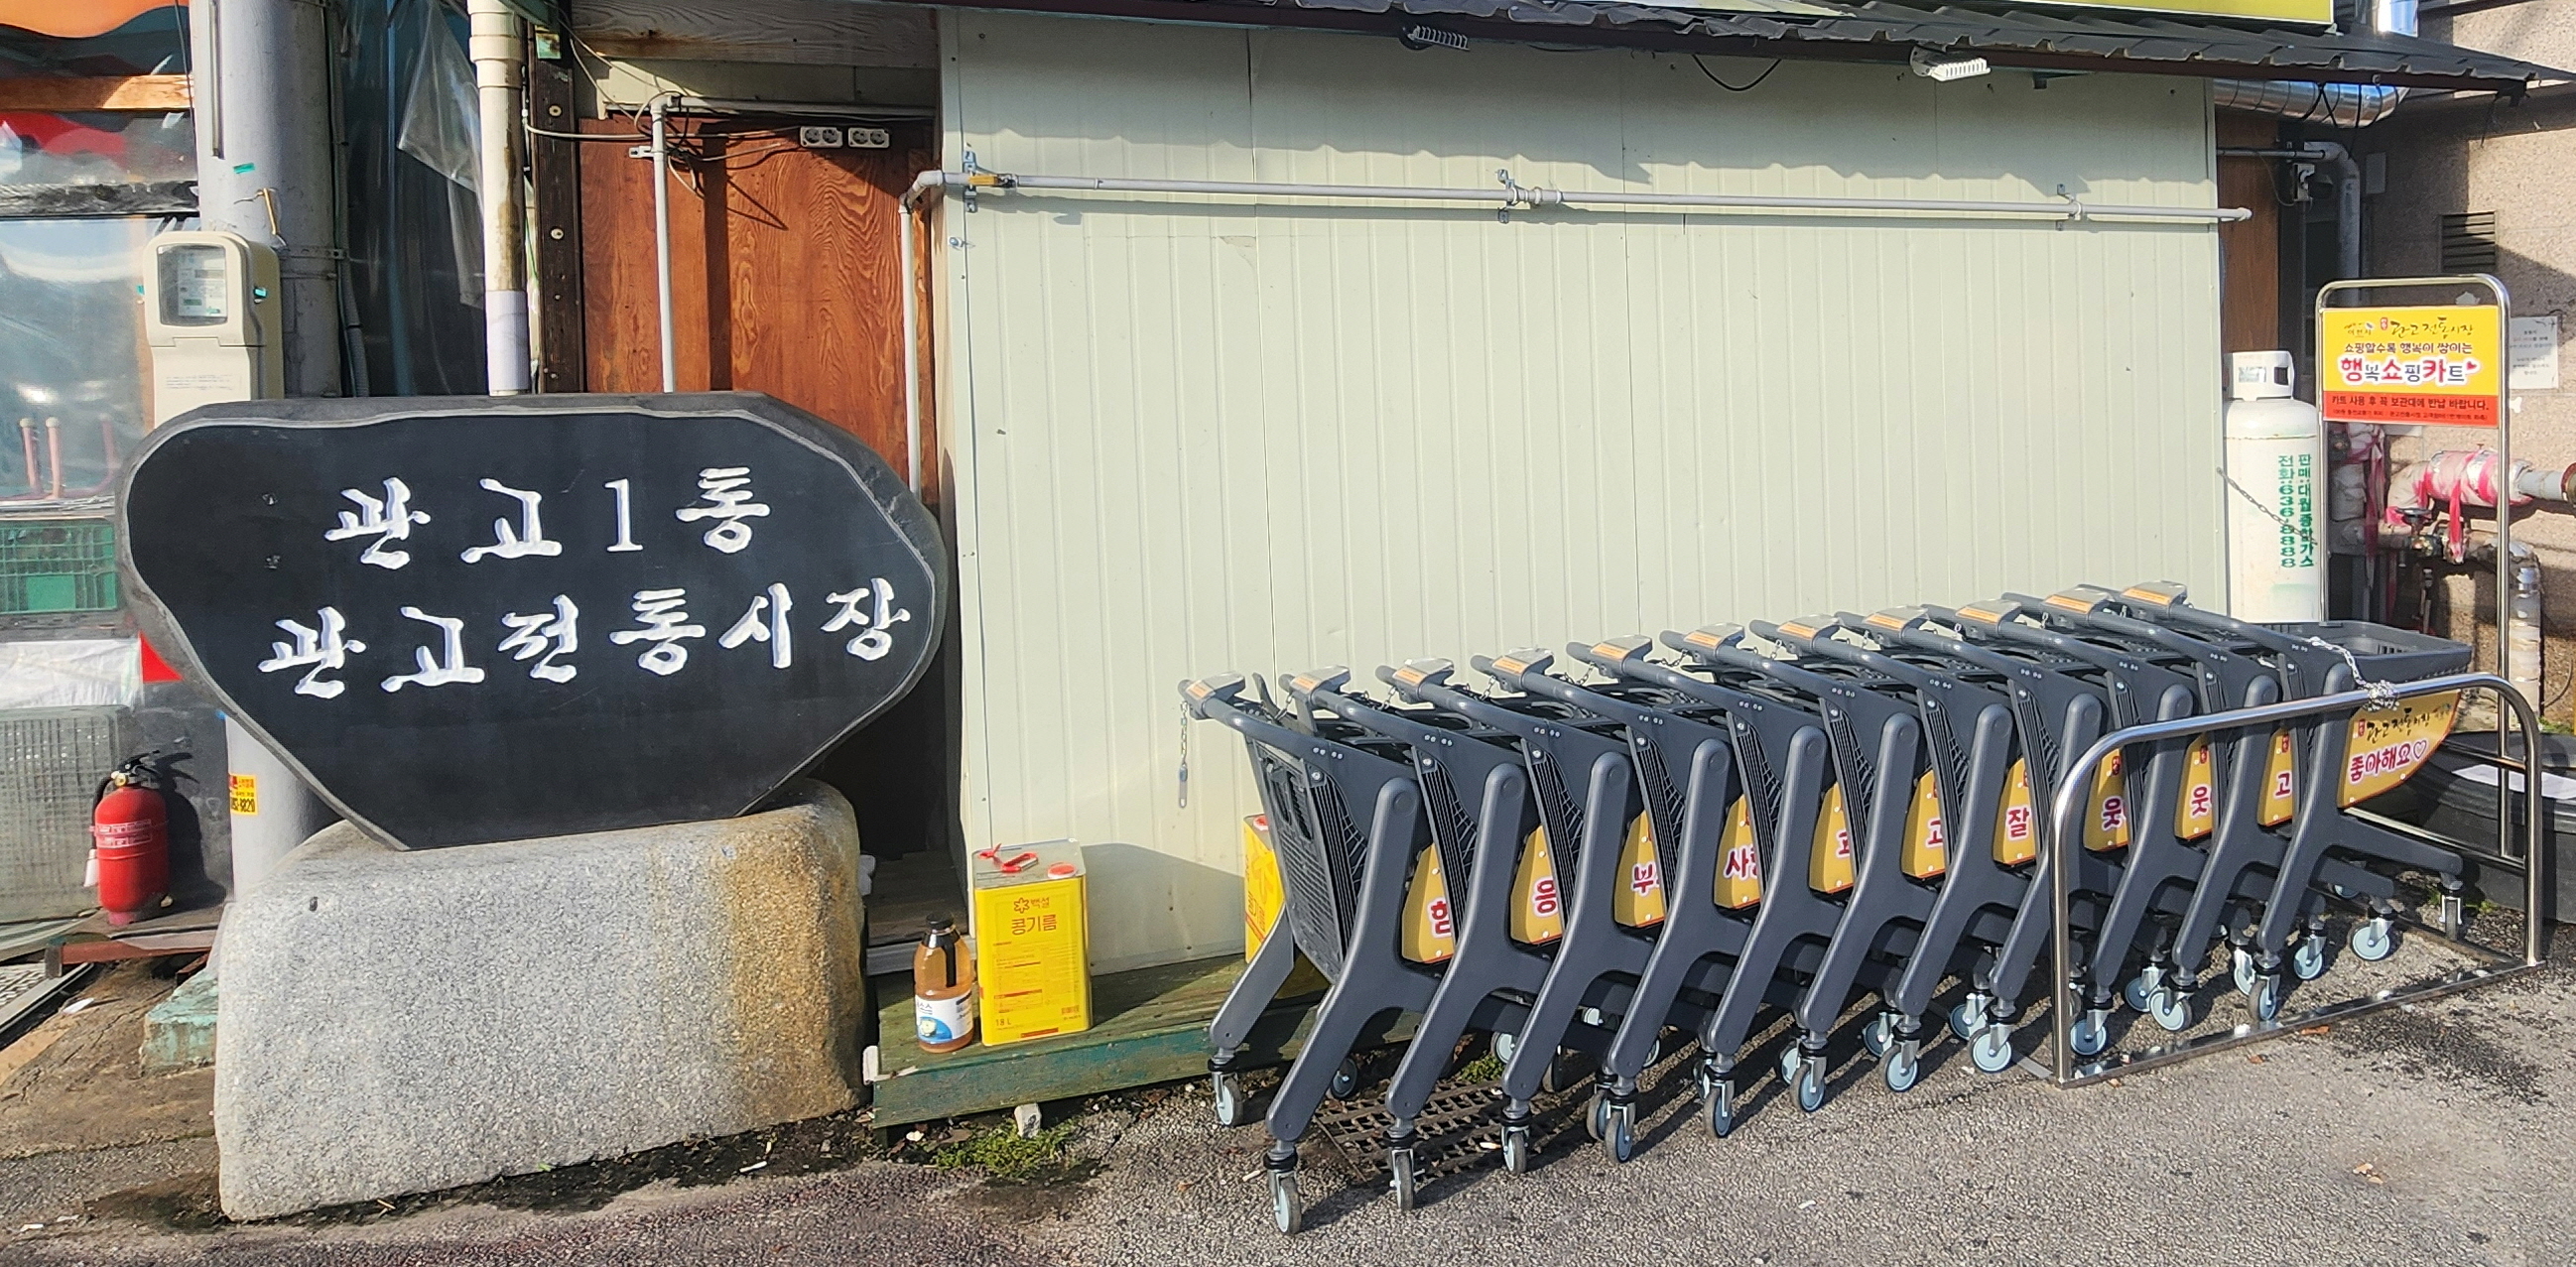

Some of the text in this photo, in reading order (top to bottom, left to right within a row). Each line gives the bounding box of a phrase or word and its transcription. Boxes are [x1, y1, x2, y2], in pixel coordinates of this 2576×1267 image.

[2399, 342, 2434, 353] 행복이
[2437, 343, 2473, 354] 쌓이는
[2332, 396, 2347, 405] 카트
[2349, 396, 2366, 406] 사용
[2368, 396, 2377, 406] 후
[2390, 397, 2425, 408] 보관대에
[2428, 398, 2446, 409] 반납
[2449, 399, 2490, 411] 바랍니다.
[258, 576, 911, 699] 관고전통시장
[2350, 742, 2411, 782] 좋아해요
[2007, 807, 2030, 837] 잘
[1030, 896, 1050, 909] 백설
[1011, 914, 1057, 936] 콩기름
